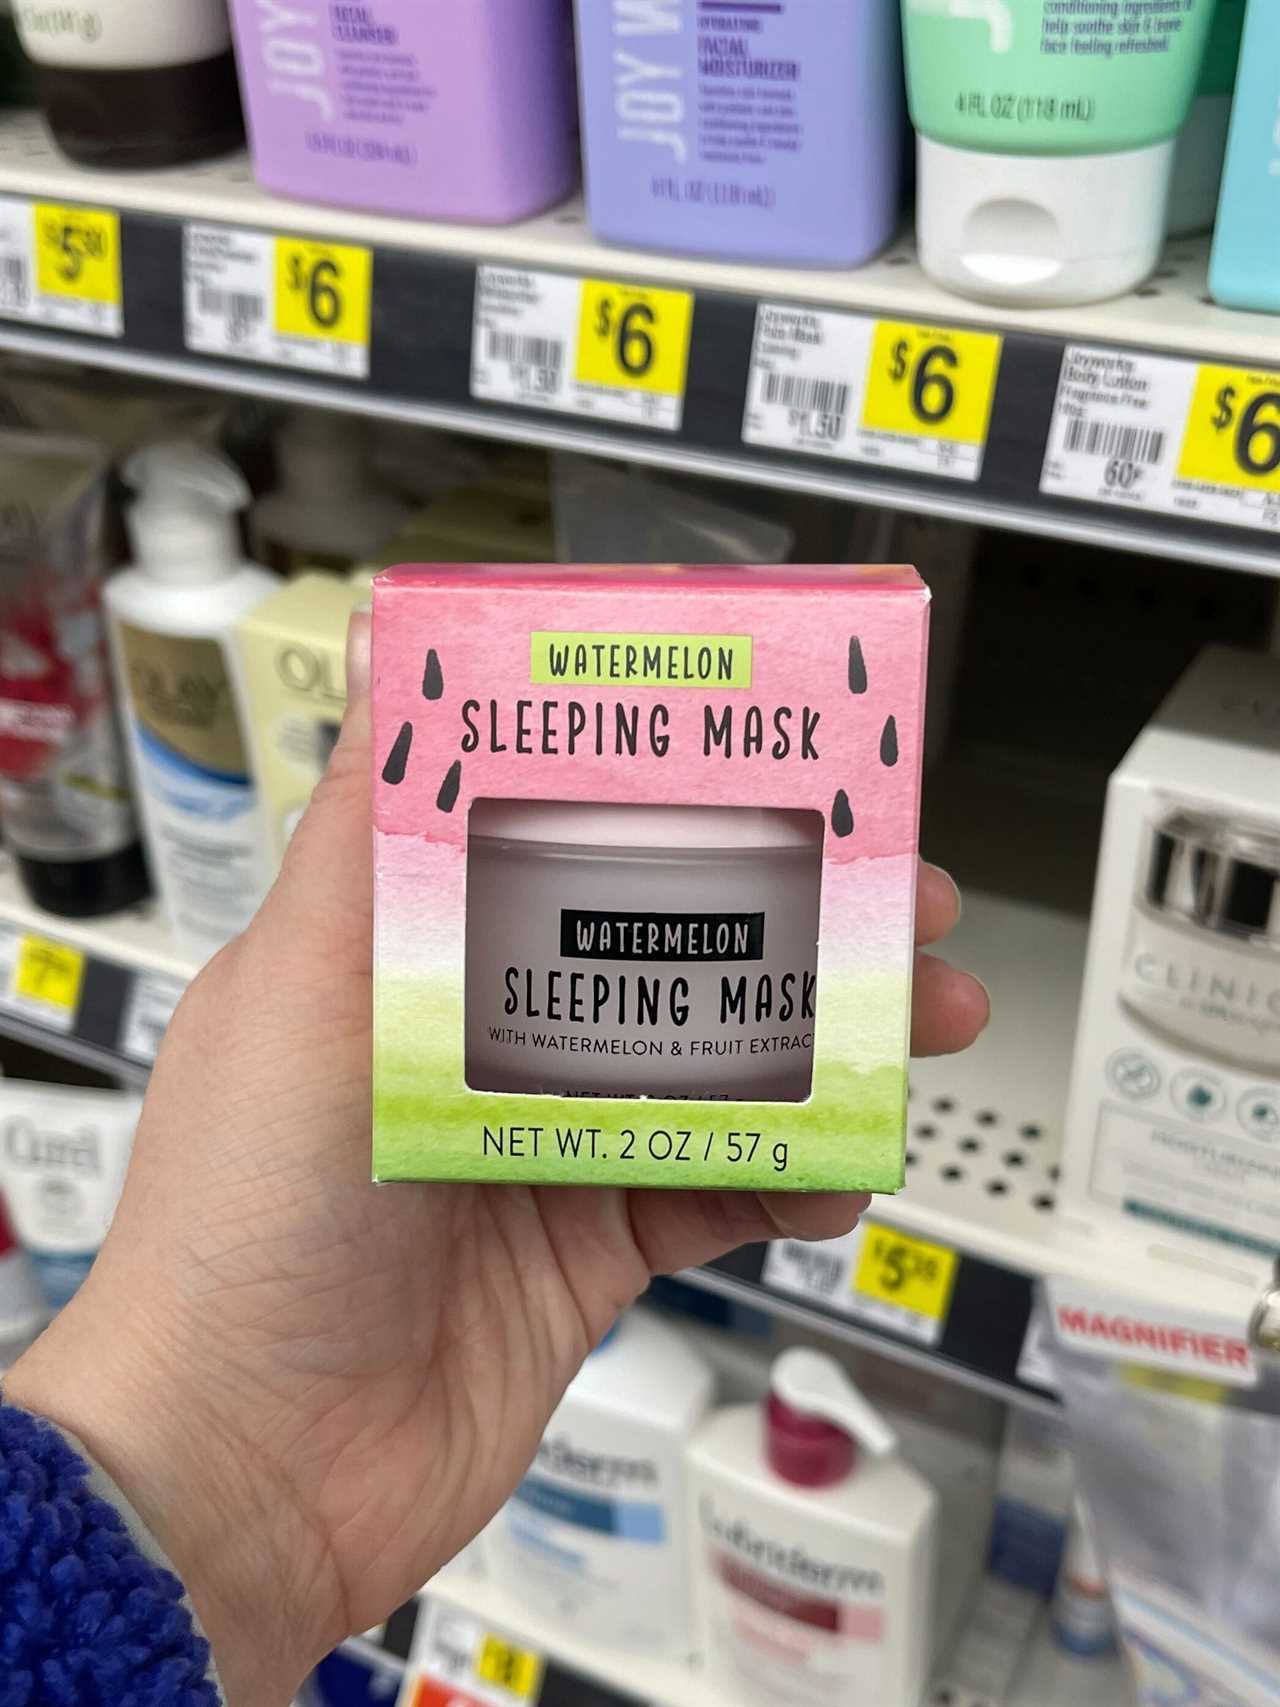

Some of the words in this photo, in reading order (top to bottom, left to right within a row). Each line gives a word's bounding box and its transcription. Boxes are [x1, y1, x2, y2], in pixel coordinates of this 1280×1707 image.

[698, 35, 748, 57] FACIAL
[1073, 19, 1114, 34] soothe
[1118, 18, 1140, 33] skin
[699, 56, 800, 80] MOISTURIZER
[615, 50, 687, 165] JOY
[990, 94, 1016, 120] OZ
[287, 252, 342, 328] $6
[595, 297, 656, 379] $6
[889, 338, 959, 426] $6
[1211, 382, 1280, 476] $6
[549, 643, 734, 680] WATERMELON
[461, 699, 670, 757] SLEEPING
[703, 705, 820, 760] MASK
[576, 920, 749, 954] WATERMELON
[504, 966, 690, 1026] SLEEPING
[720, 970, 815, 1025] MASK
[488, 1024, 526, 1045] WITH
[532, 1033, 663, 1056] WATERMELON
[671, 1041, 682, 1056] &
[690, 1039, 744, 1056] FRUIT
[750, 1032, 815, 1053] EXTRAC
[483, 1126, 543, 1157] NET
[556, 1128, 607, 1160] WT.
[620, 1130, 635, 1160] 2
[648, 1130, 691, 1161] OZ
[704, 1132, 714, 1161] /
[727, 1132, 761, 1162] 57
[773, 1142, 788, 1172] g
[1056, 1304, 1250, 1366] MAGNIFIER
